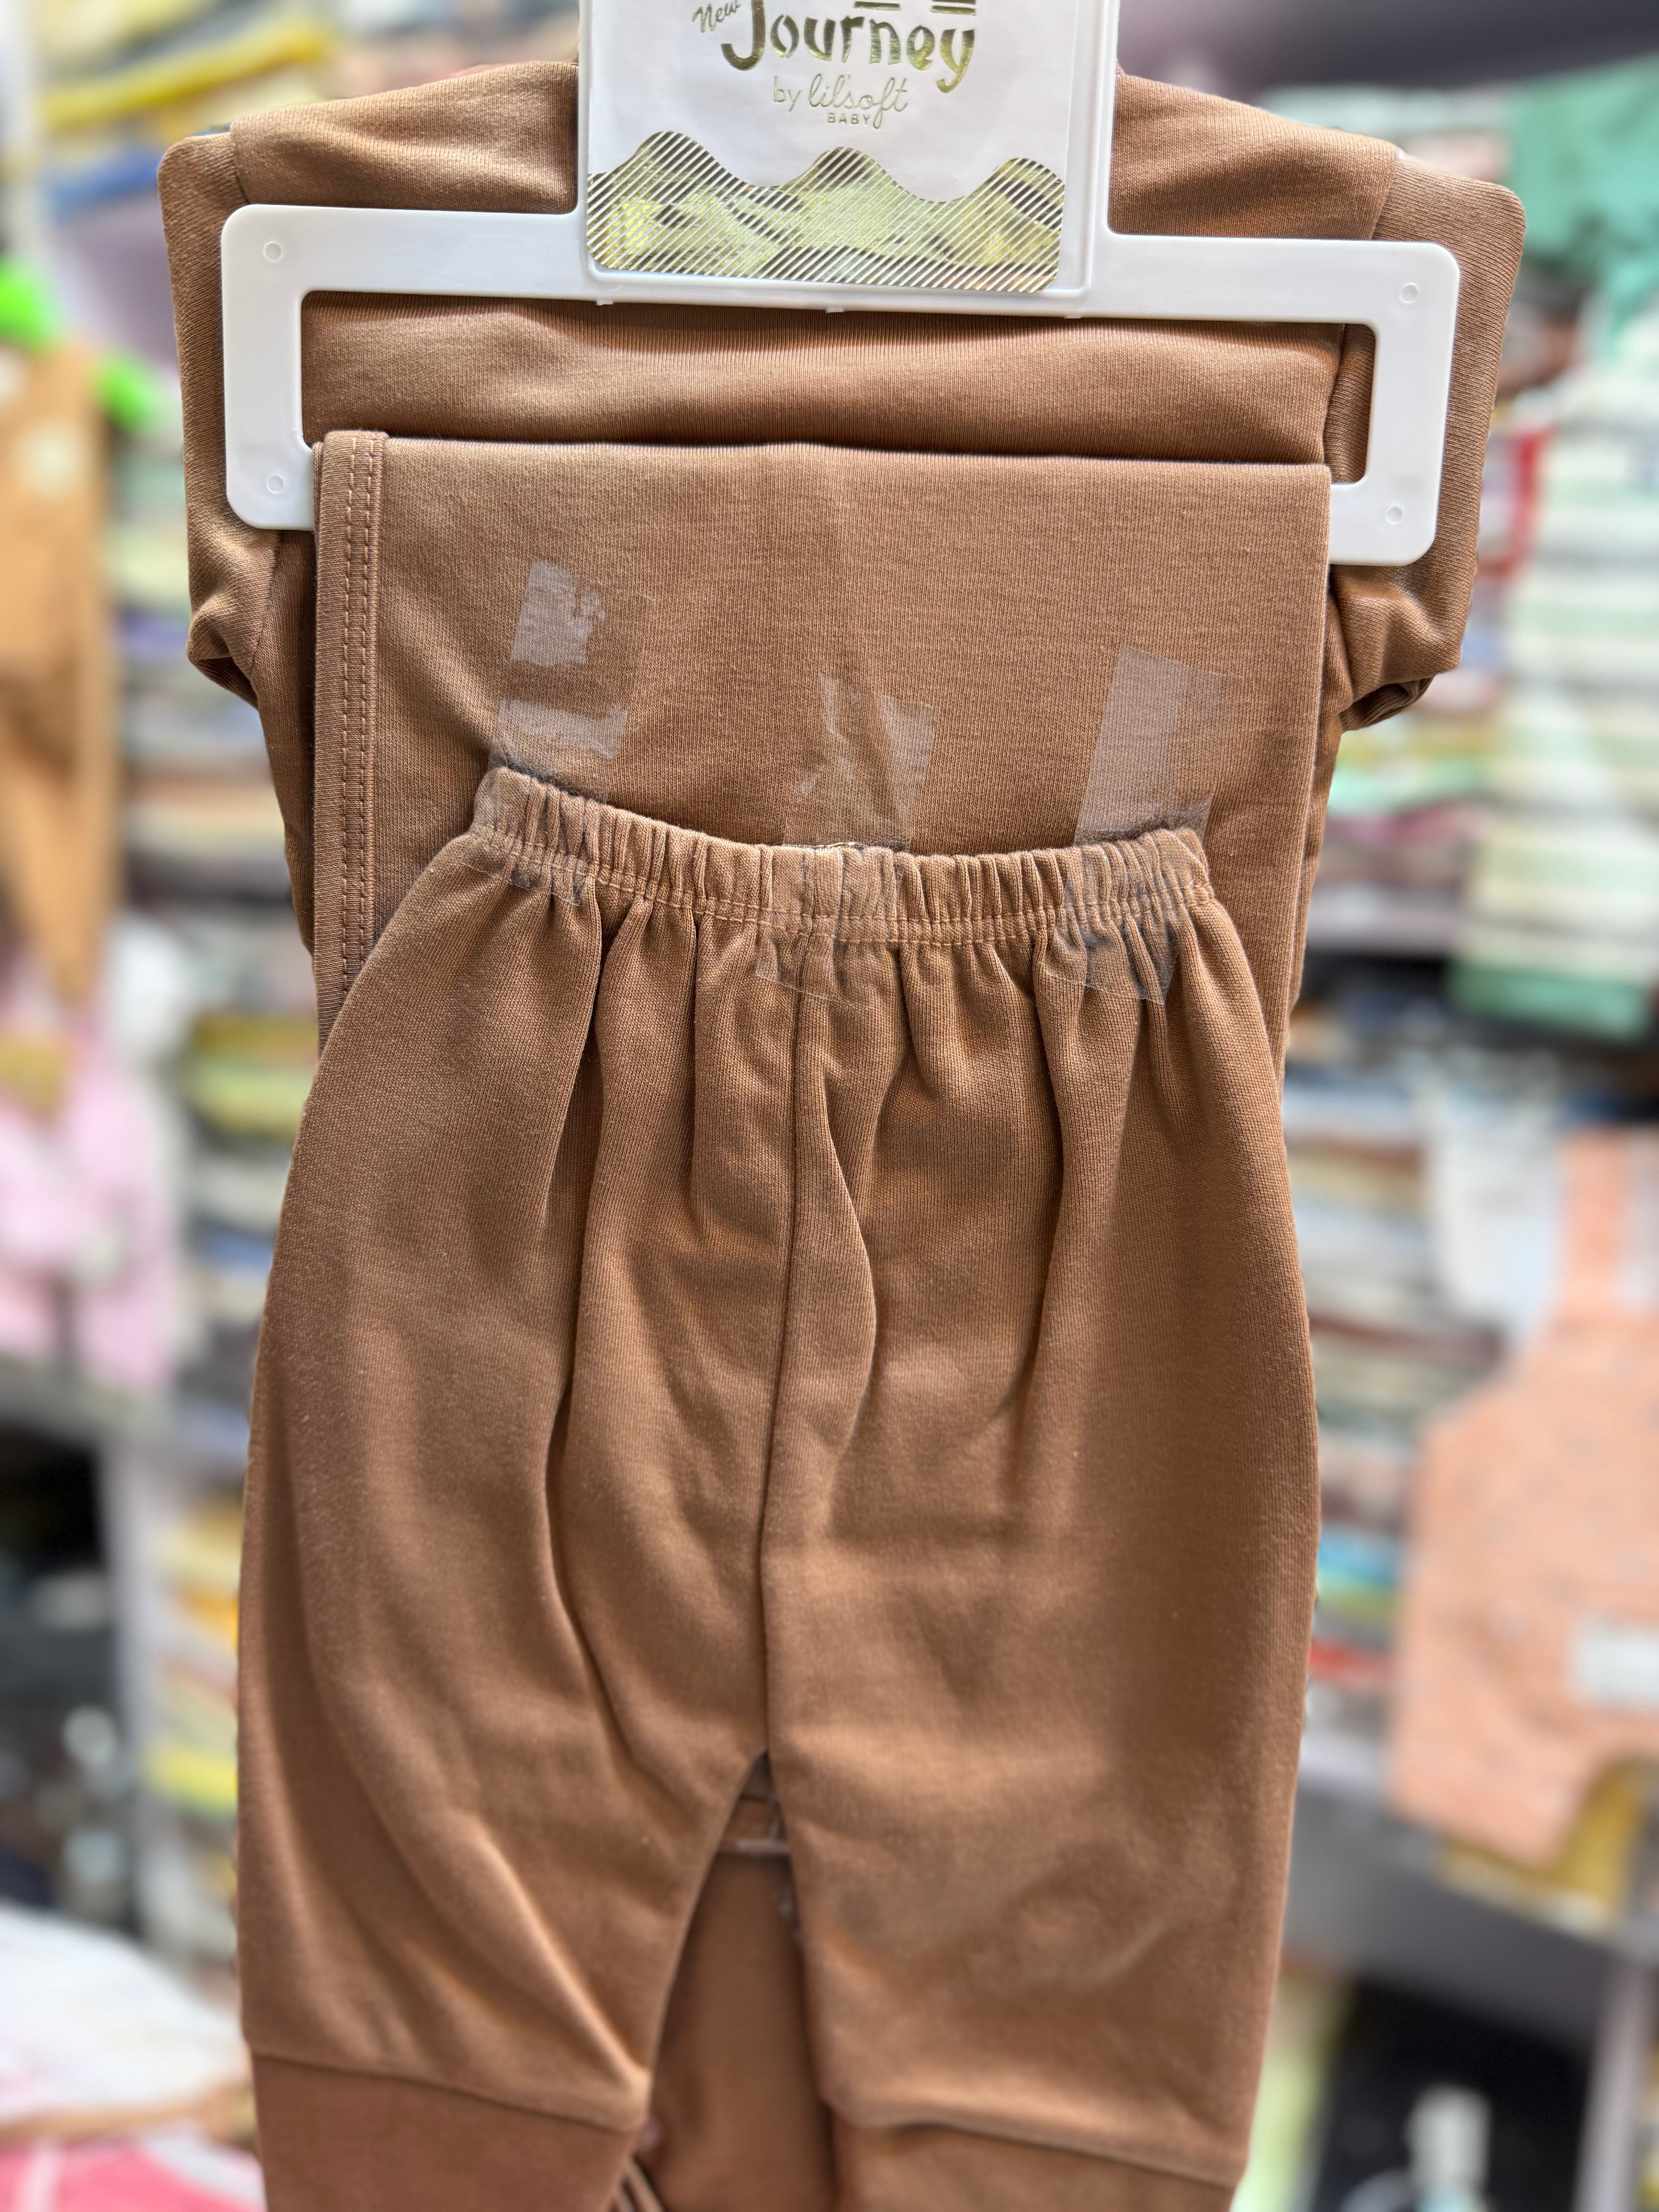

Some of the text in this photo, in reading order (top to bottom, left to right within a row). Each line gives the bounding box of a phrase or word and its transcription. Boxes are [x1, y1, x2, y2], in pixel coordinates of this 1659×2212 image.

[692, 0, 741, 33] New
[721, 0, 975, 93] Journey
[773, 76, 801, 112] by
[827, 112, 871, 125] BABY
